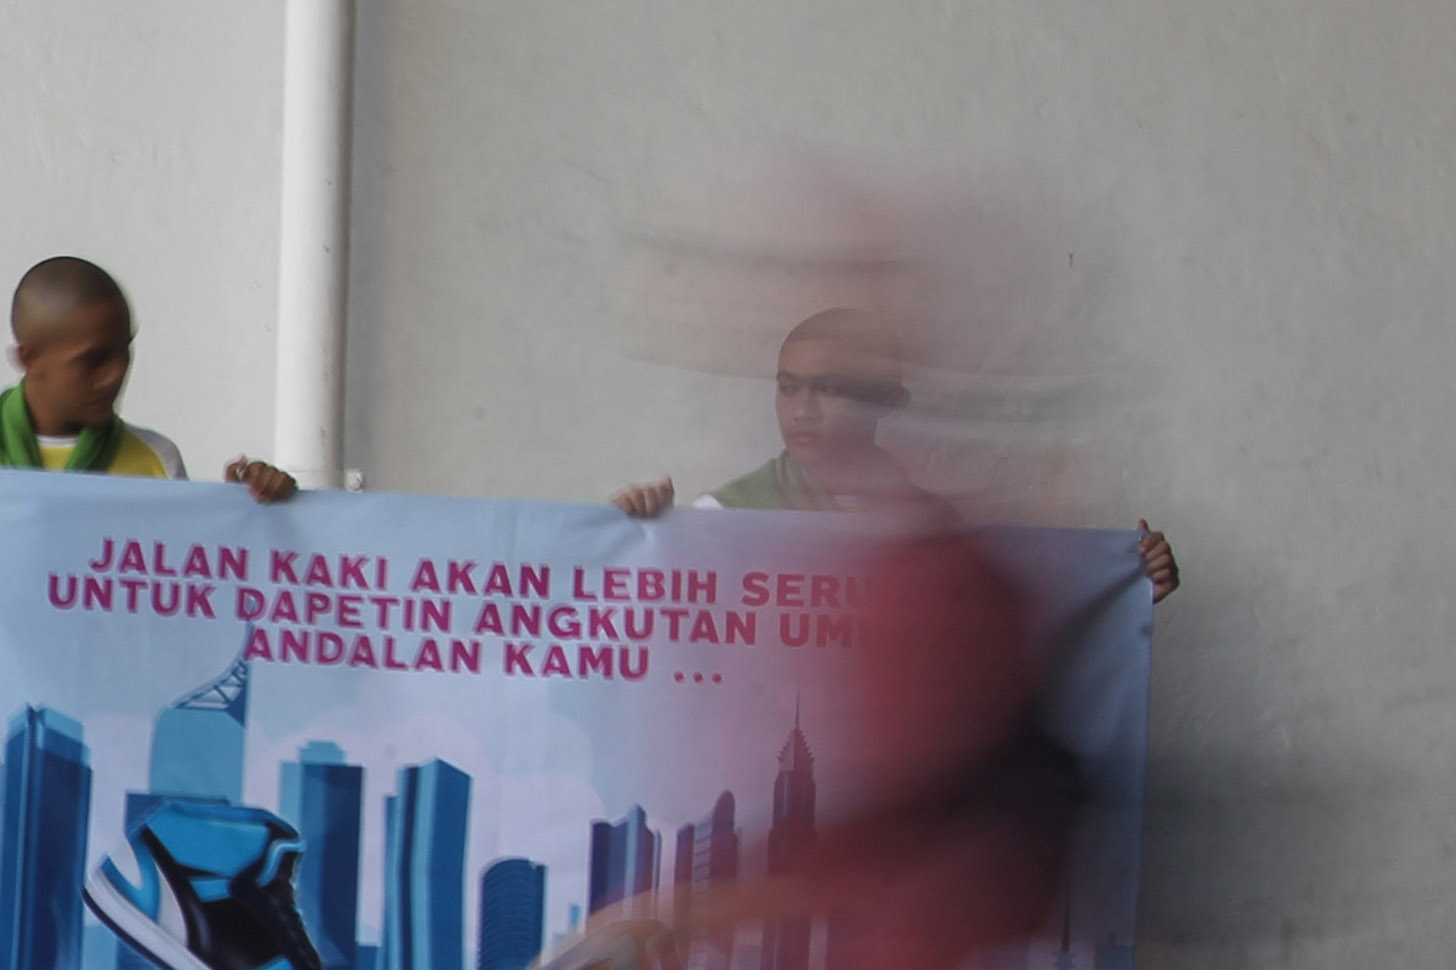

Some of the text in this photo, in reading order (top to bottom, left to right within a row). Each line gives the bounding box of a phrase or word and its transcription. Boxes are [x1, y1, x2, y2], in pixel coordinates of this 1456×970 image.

[89, 537, 249, 580] JALAN
[269, 548, 389, 592] KAKI
[410, 558, 551, 600] AKAN
[572, 566, 718, 604] LEBIH
[47, 572, 217, 620] UNTUK
[236, 588, 453, 634] DAPETIN
[474, 602, 757, 645] ANGKUTAN
[244, 627, 481, 674] ANDALAN
[502, 642, 649, 681] KAMU
